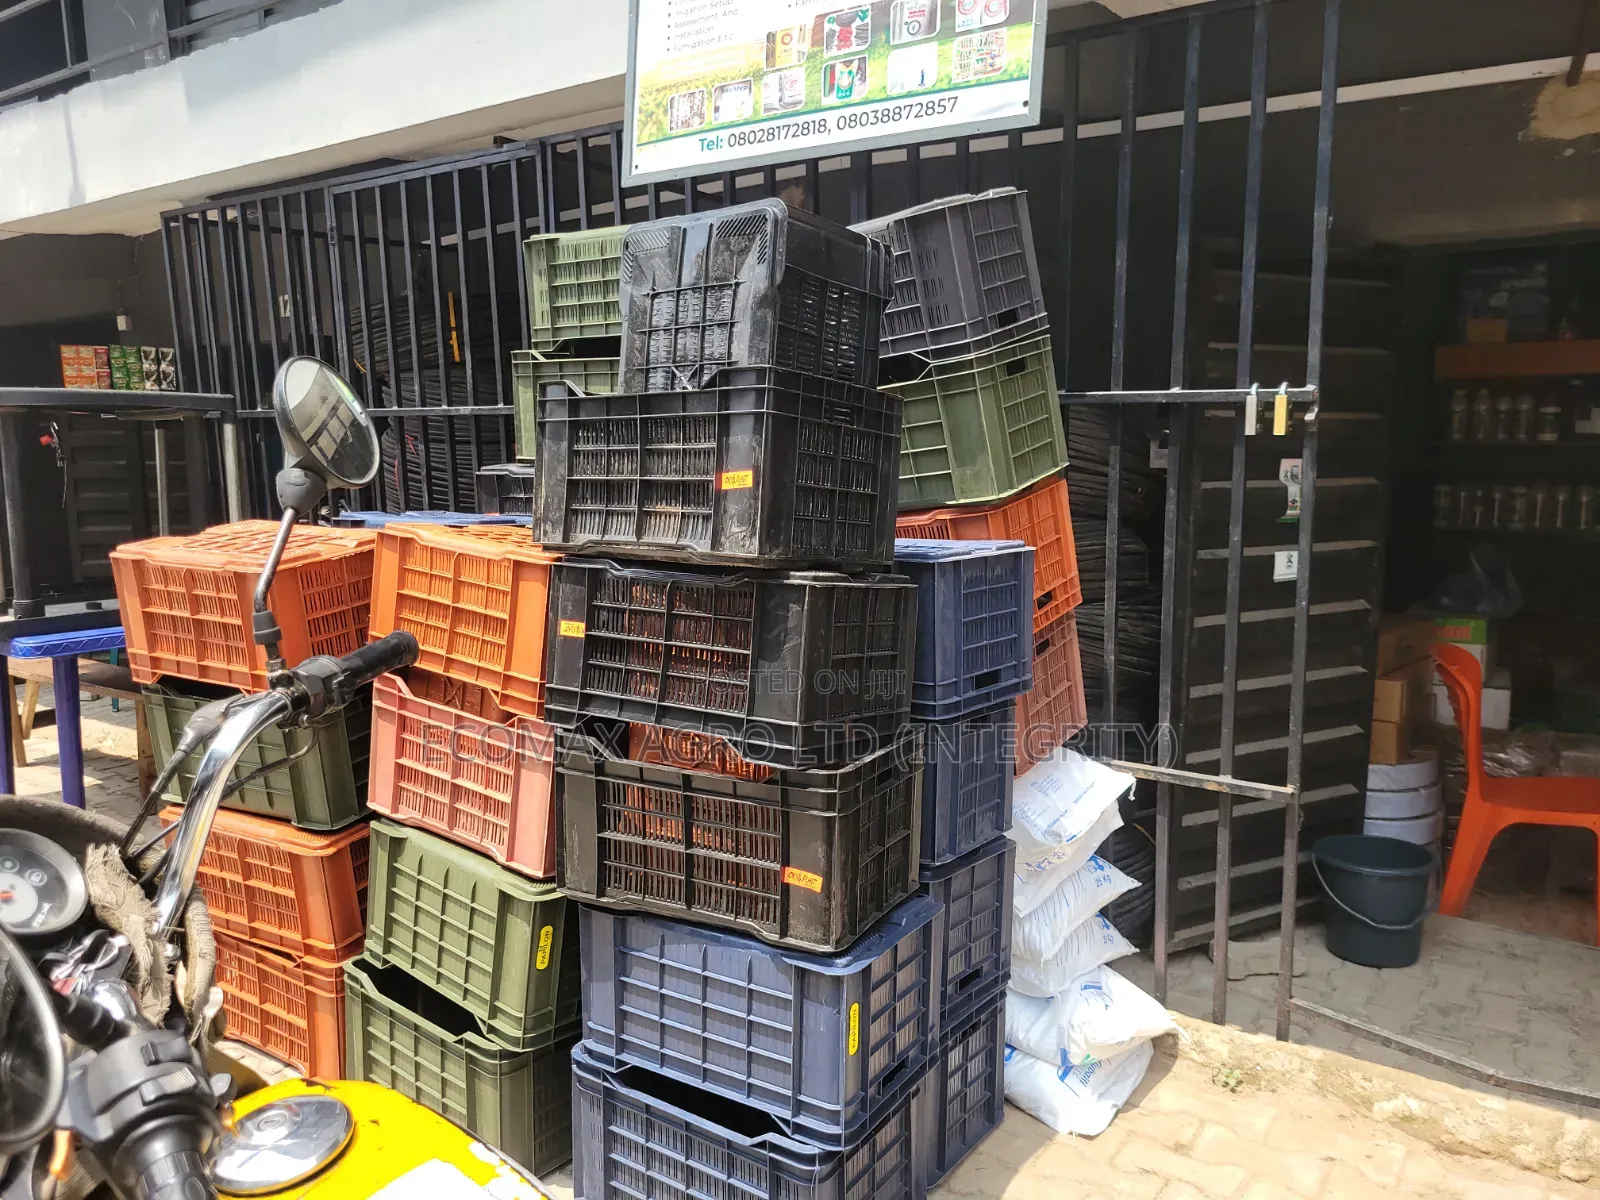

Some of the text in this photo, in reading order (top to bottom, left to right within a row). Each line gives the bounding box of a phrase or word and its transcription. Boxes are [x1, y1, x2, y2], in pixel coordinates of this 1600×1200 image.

[698, 96, 959, 152] Tel: 08028172818, 08038872857
